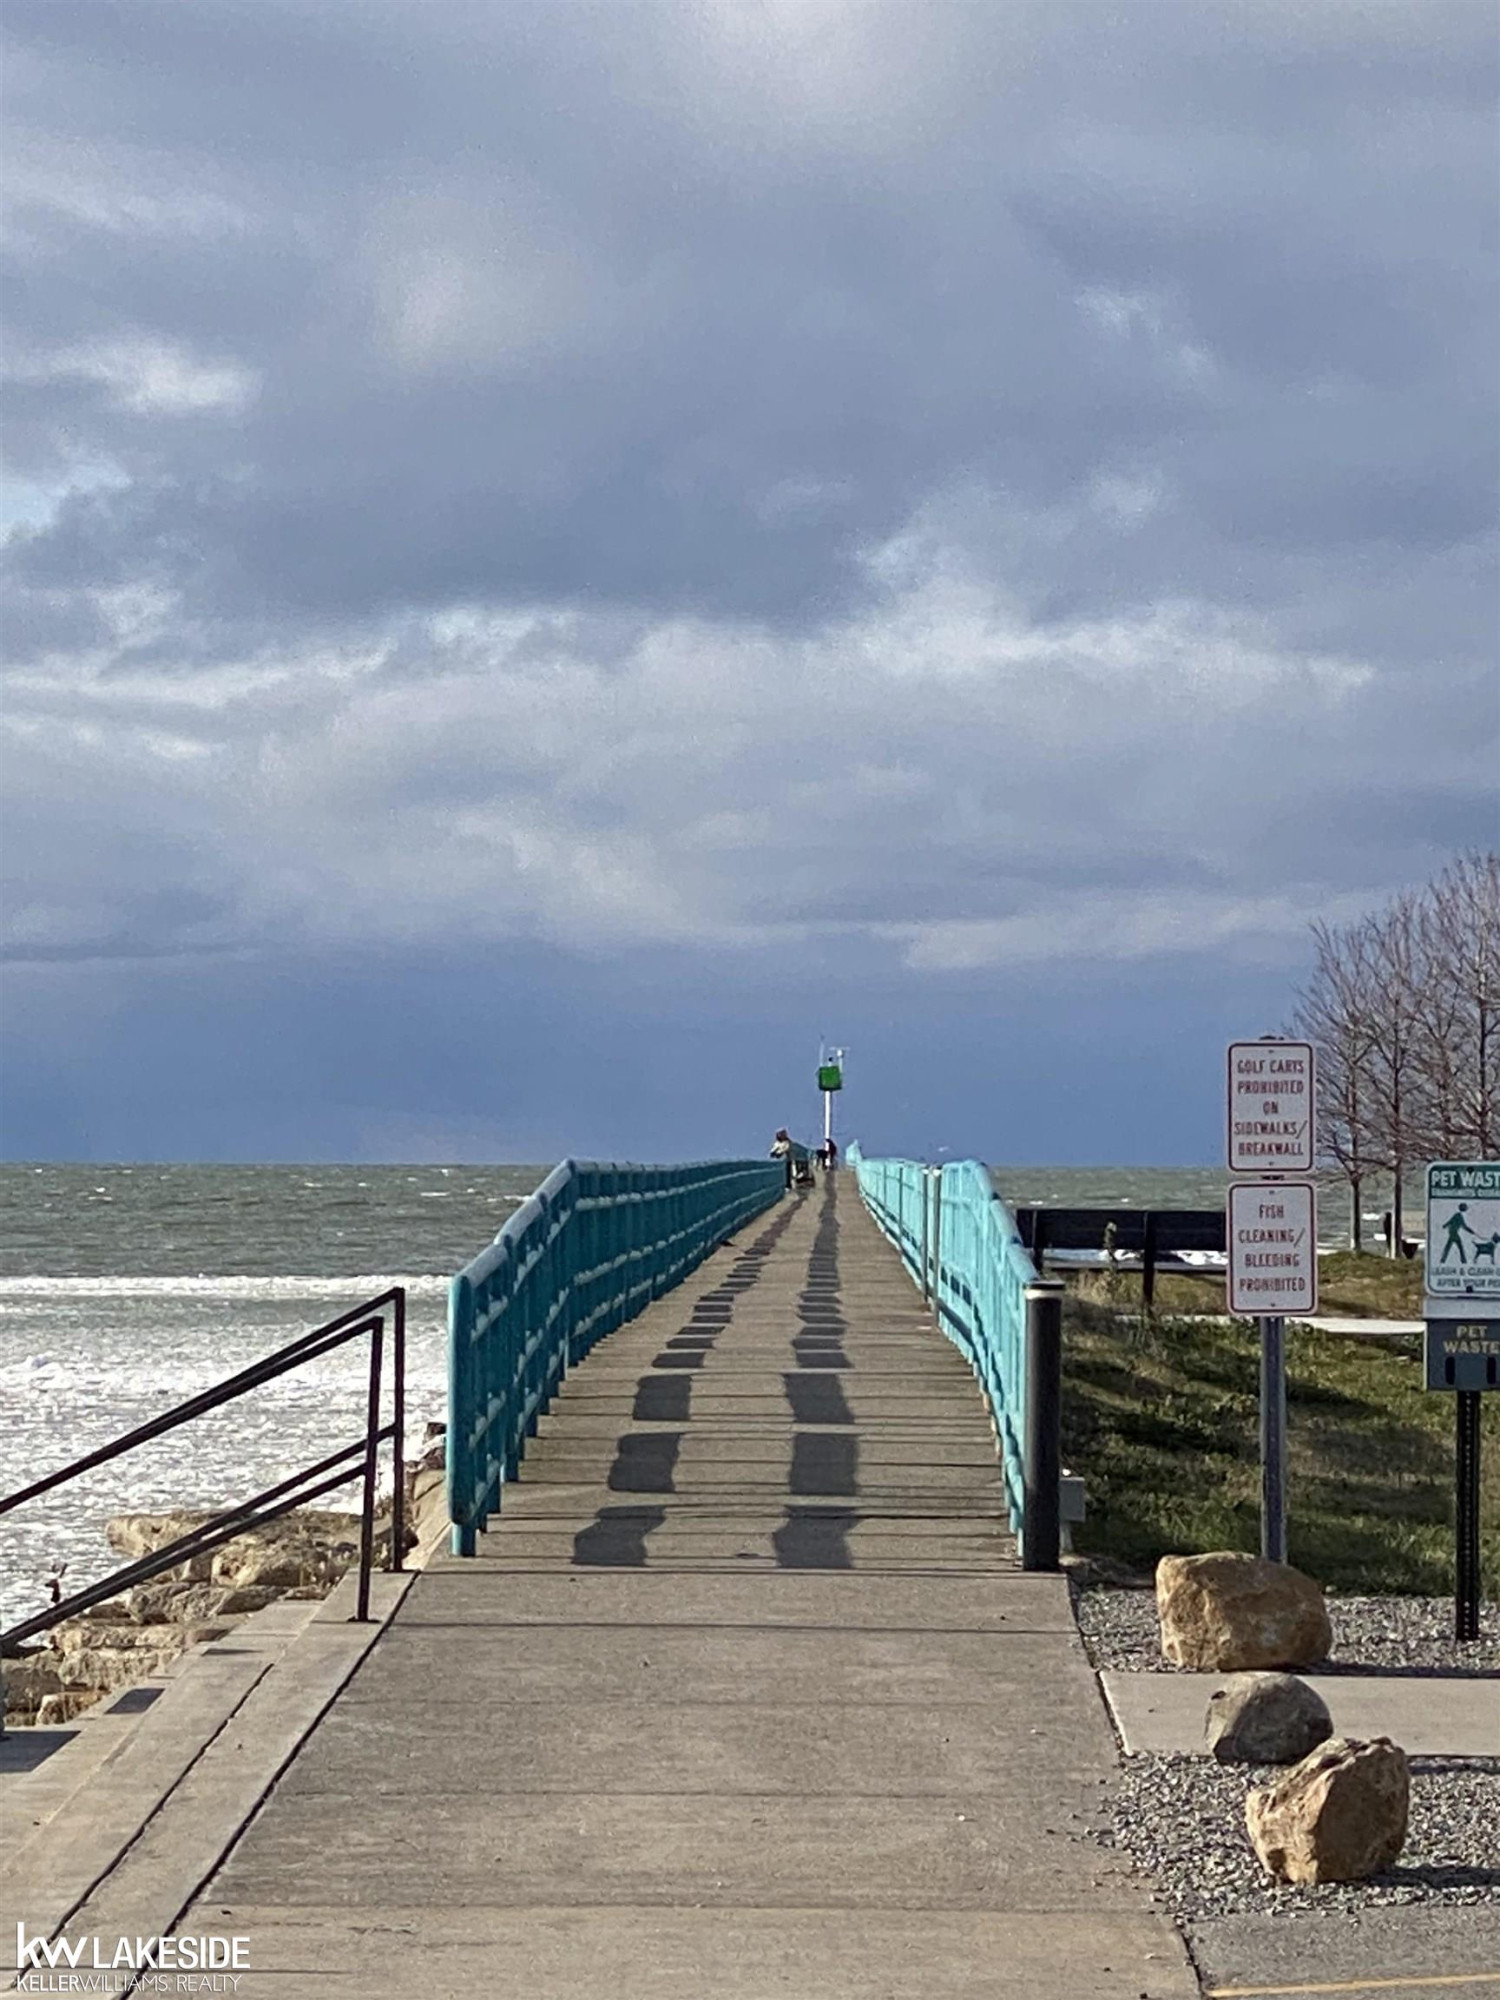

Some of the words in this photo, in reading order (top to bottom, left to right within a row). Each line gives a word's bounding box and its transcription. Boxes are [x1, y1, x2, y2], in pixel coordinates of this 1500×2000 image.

[1237, 1060, 1265, 1074] GOLF
[1270, 1060, 1304, 1074] CARTS
[1238, 1080, 1304, 1094] PROHIBITED
[1263, 1101, 1278, 1115] ON
[1234, 1121, 1308, 1139] SIDEWALKS/
[1239, 1142, 1304, 1156] BREAKWALL
[1431, 1171, 1457, 1187] PET
[1259, 1204, 1284, 1219] FISH
[1238, 1227, 1305, 1247] CLEANING/
[1245, 1253, 1300, 1267] BLEEDING
[1240, 1277, 1305, 1291] PROHIBITED
[1456, 1325, 1487, 1339] PET
[1443, 1341, 1500, 1354] WASTE
